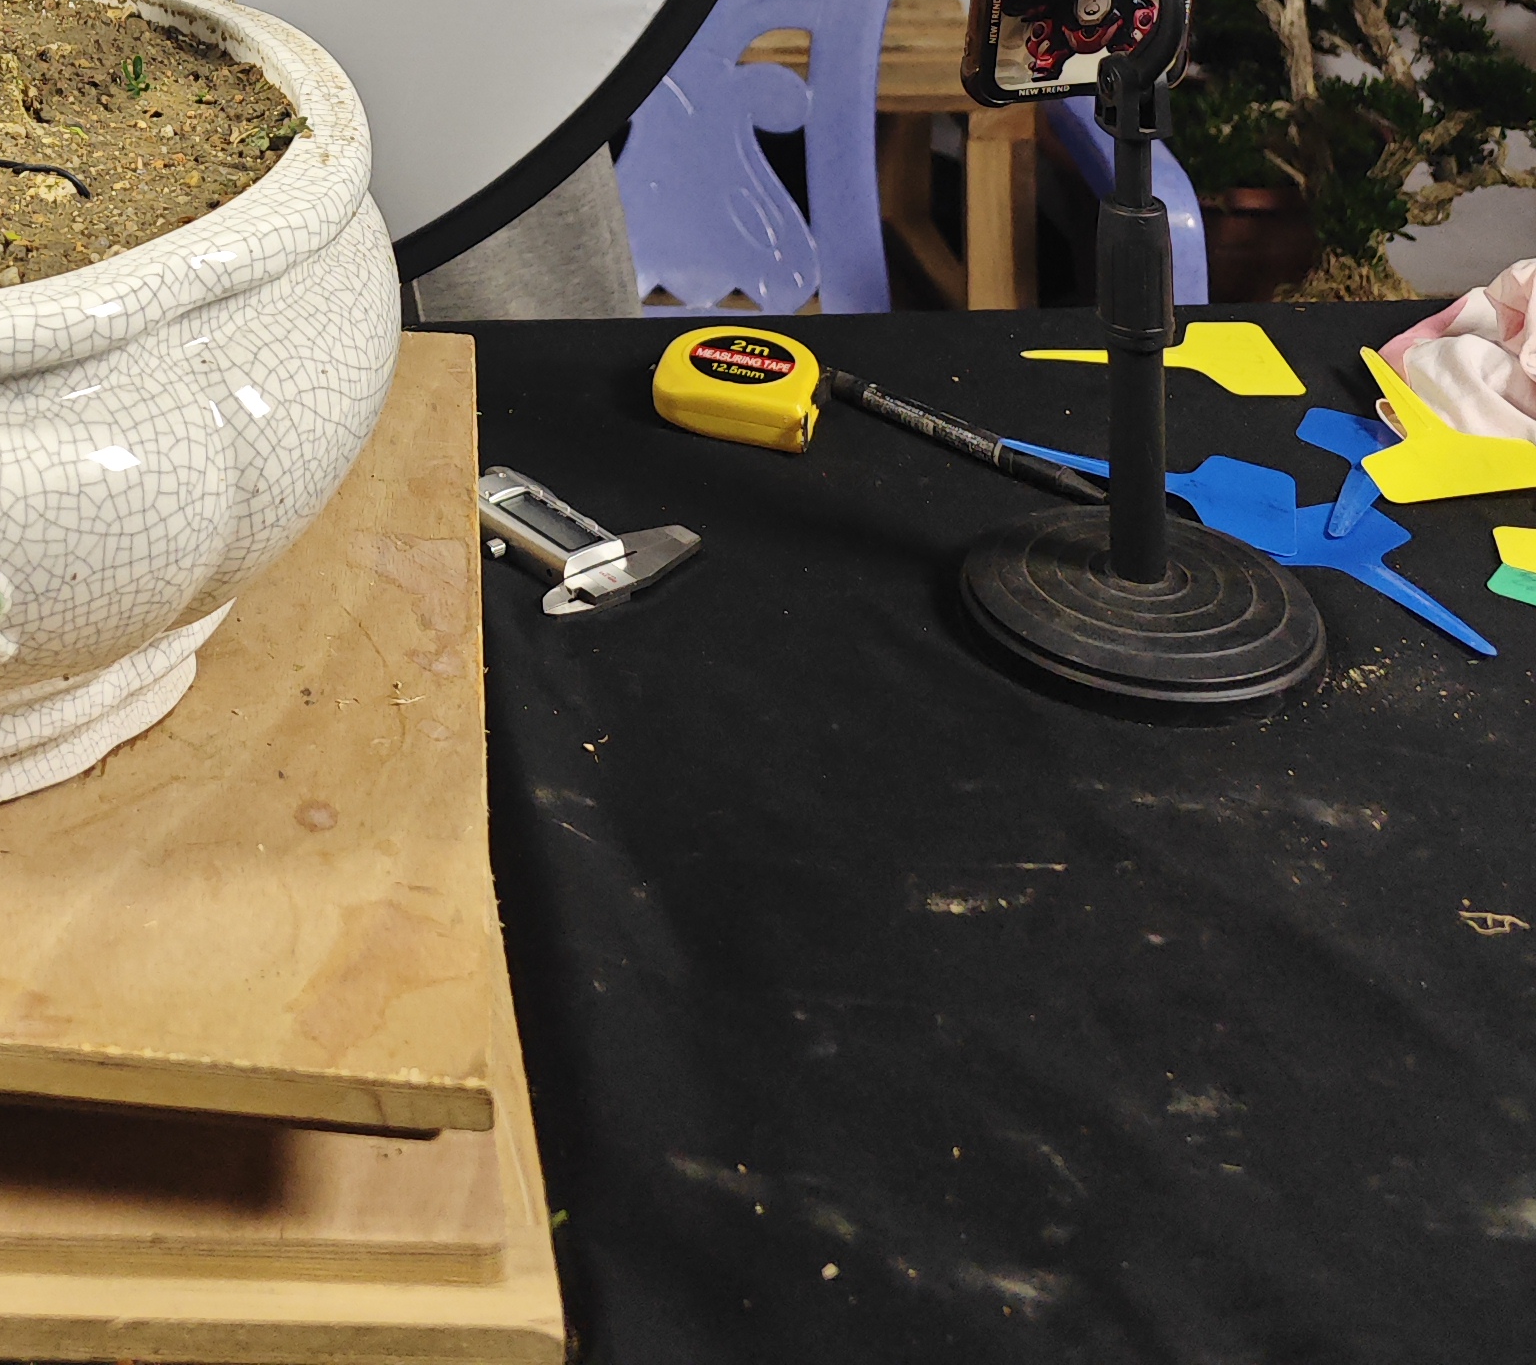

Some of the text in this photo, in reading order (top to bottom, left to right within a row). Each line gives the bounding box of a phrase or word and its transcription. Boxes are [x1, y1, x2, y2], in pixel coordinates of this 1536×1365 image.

[988, 25, 999, 44] NEW
[1018, 84, 1071, 97] NEW TREND
[730, 339, 770, 357] 2m
[695, 347, 792, 373] MEASURING TAPE
[711, 362, 765, 380] 12.5mm
